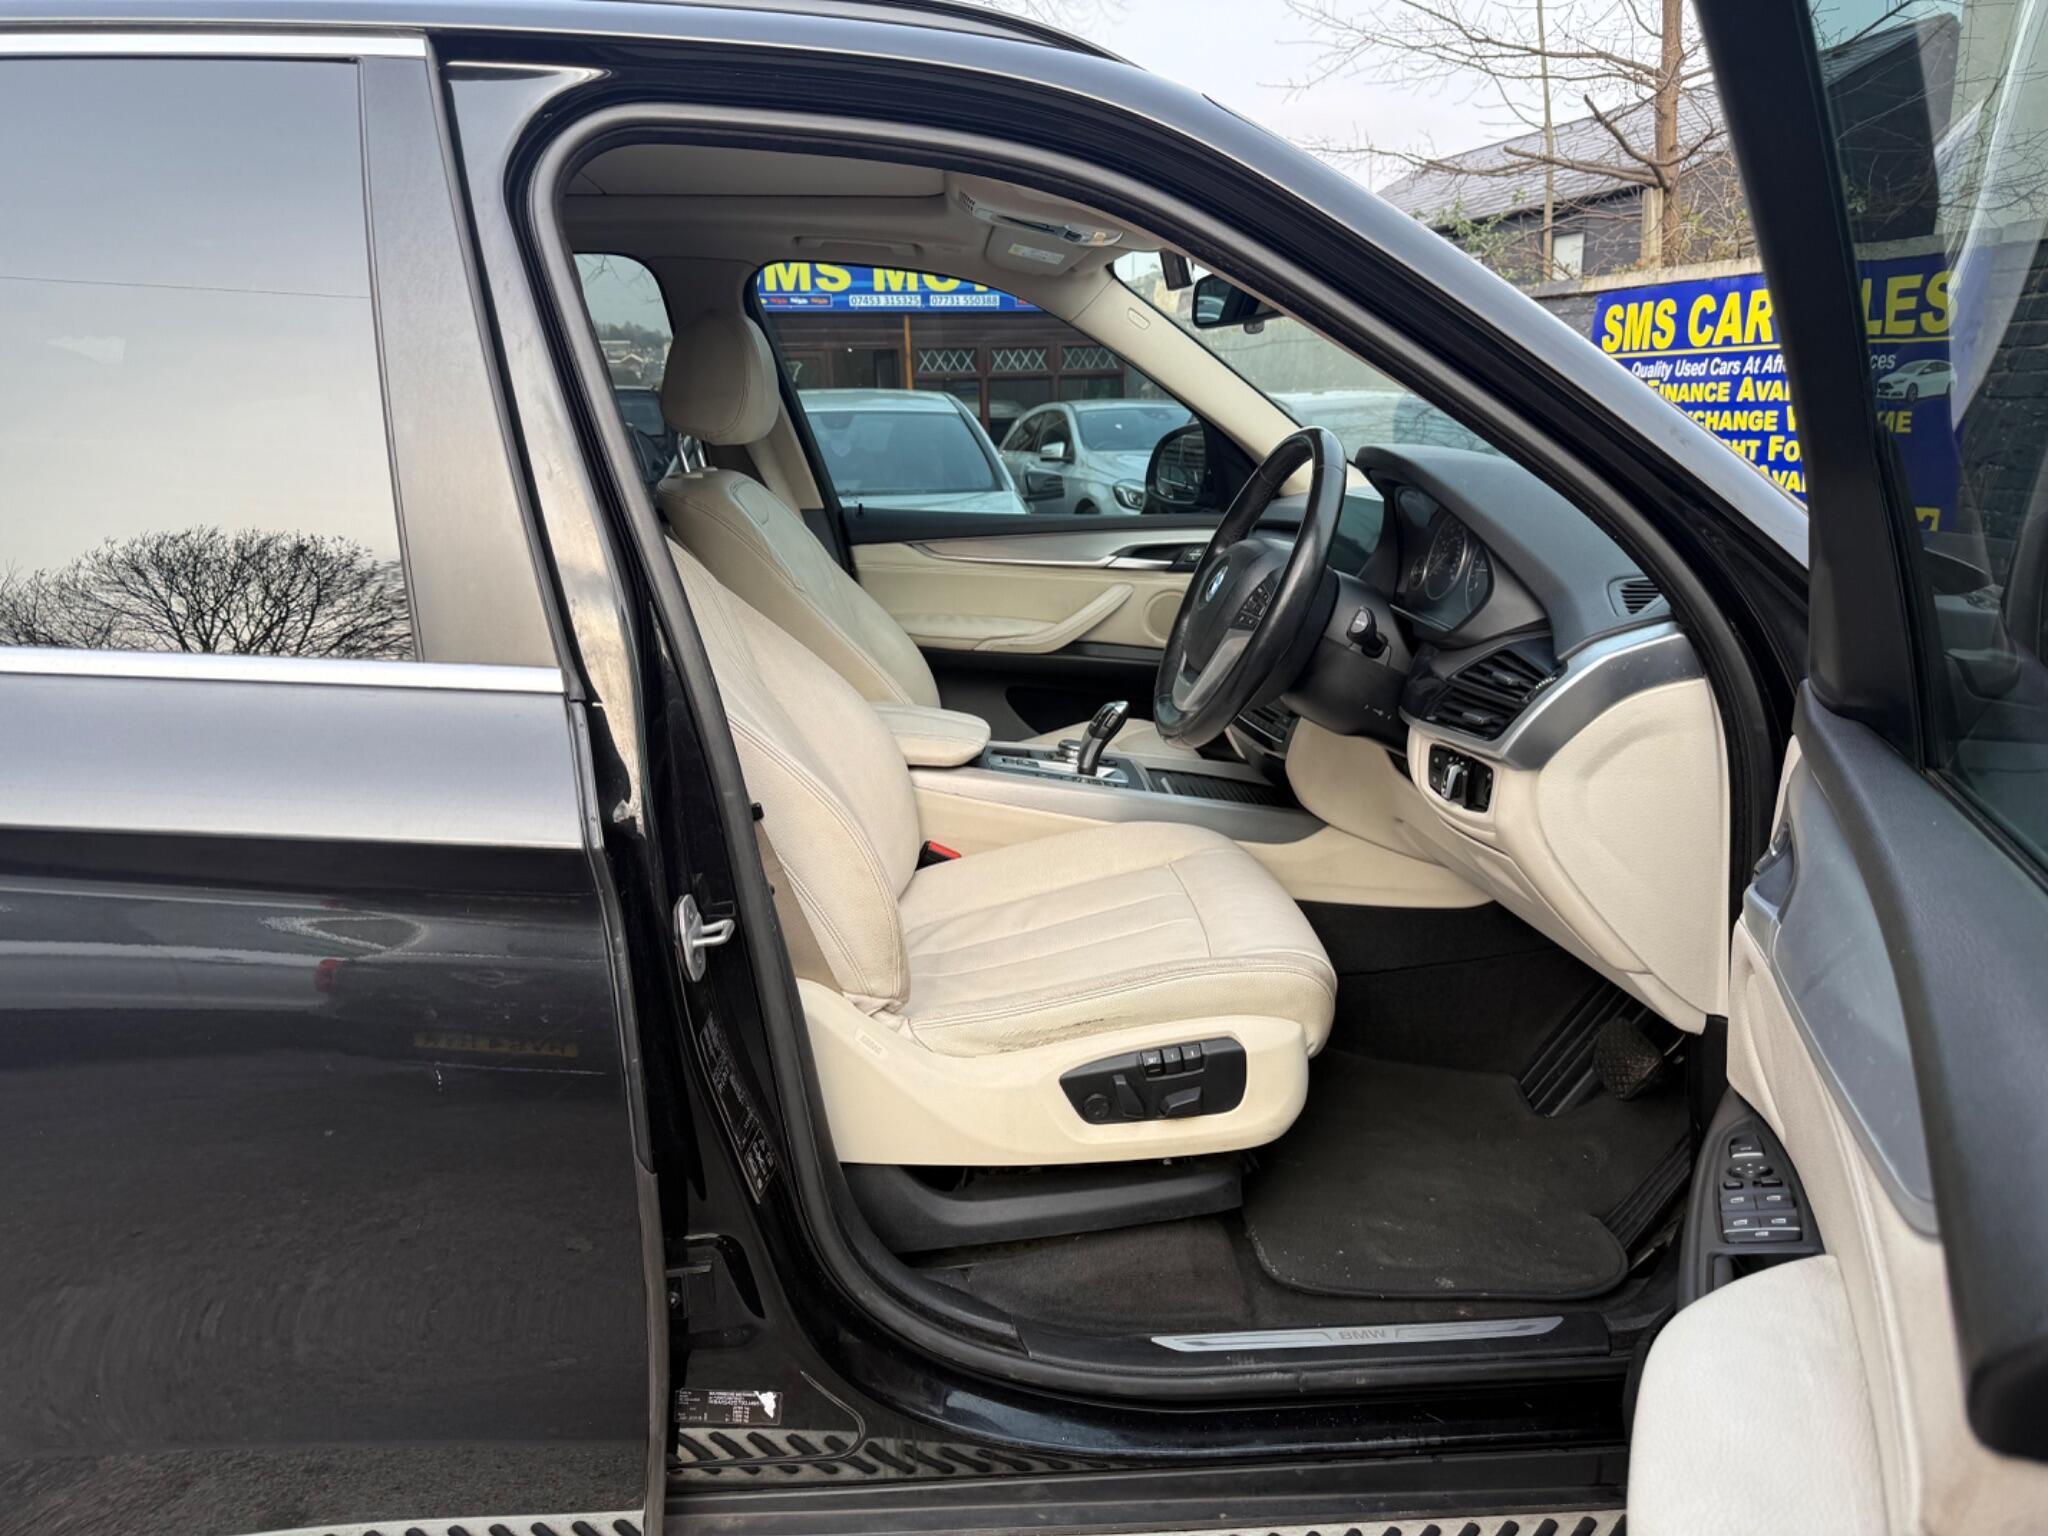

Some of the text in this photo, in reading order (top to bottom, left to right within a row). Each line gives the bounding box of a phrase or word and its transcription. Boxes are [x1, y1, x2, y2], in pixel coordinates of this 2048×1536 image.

[757, 261, 851, 291] MS
[1601, 270, 1958, 354] SMS CAR LES
[1632, 353, 1897, 381] Quality Used Cars At Aff ces
[1686, 409, 1779, 432] CHANGE
[1768, 435, 1802, 462] FO
[1338, 1329, 1385, 1340] BMW
